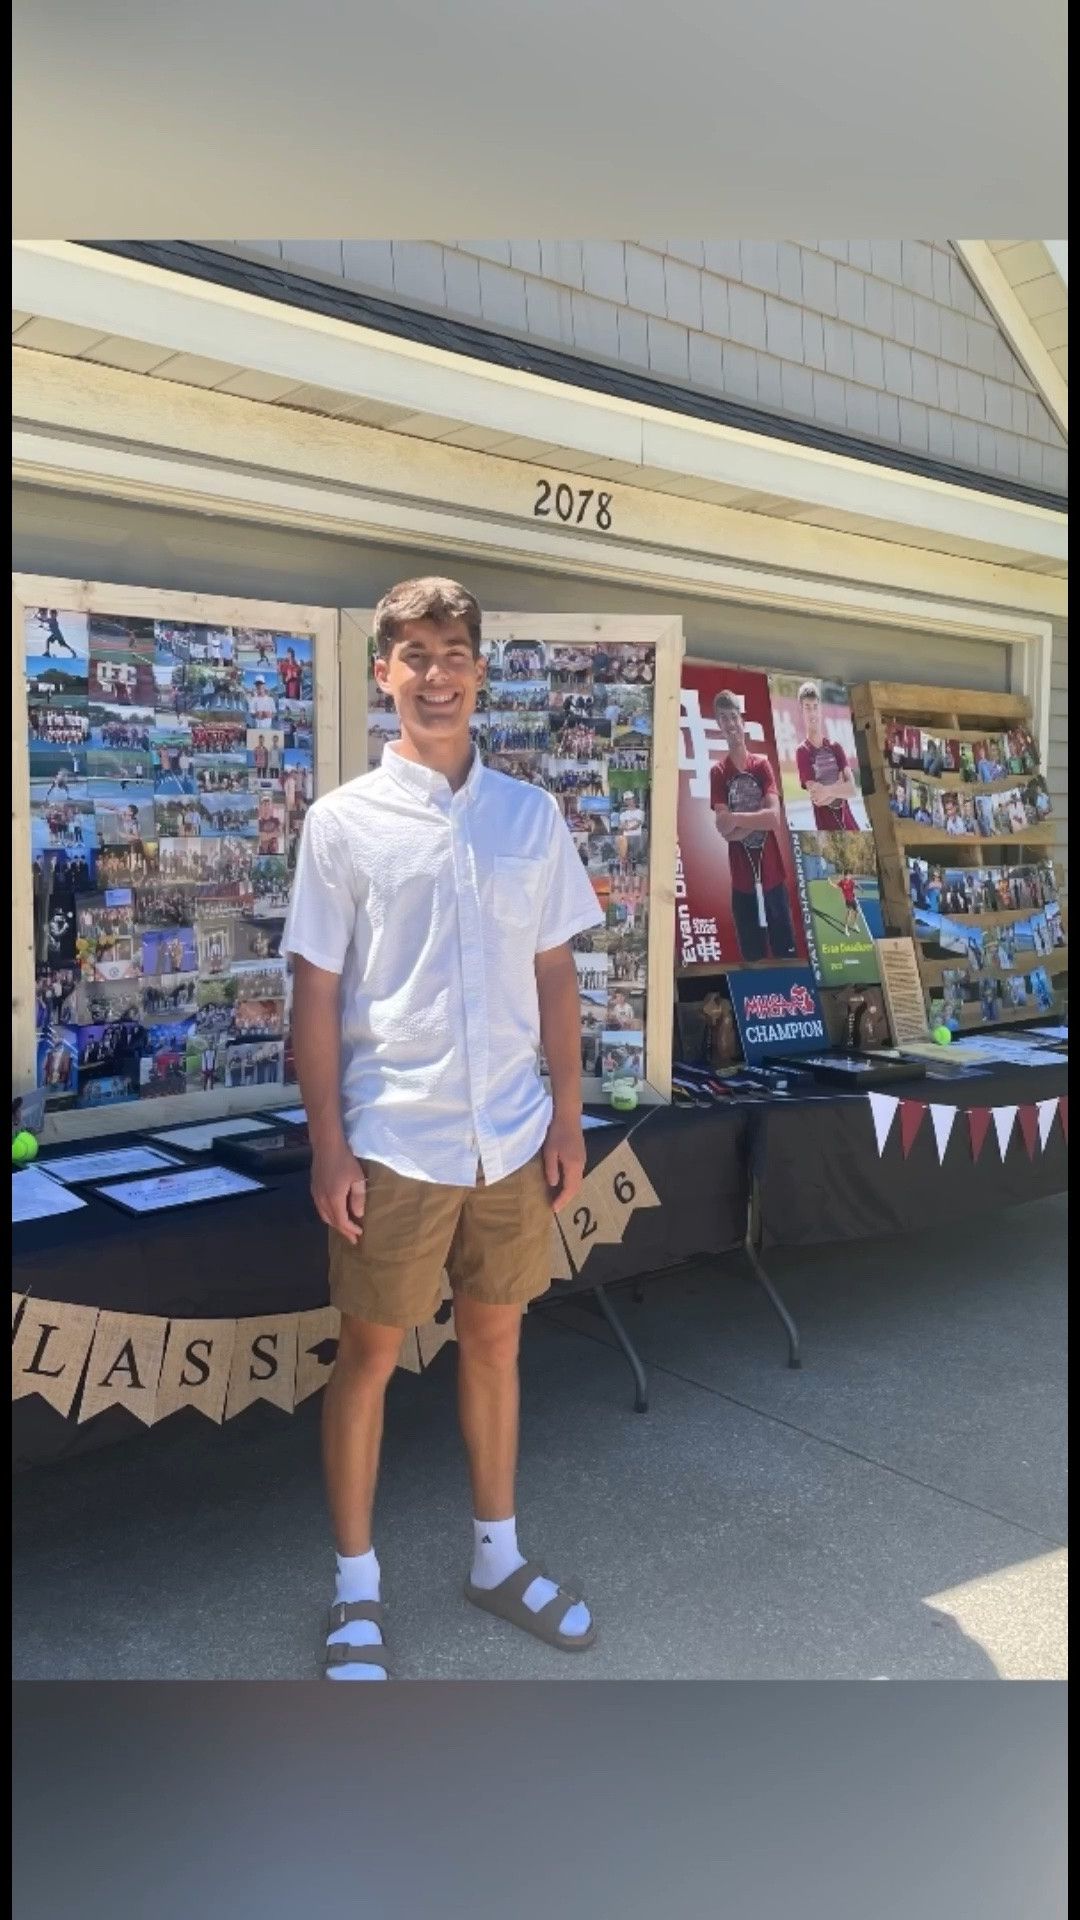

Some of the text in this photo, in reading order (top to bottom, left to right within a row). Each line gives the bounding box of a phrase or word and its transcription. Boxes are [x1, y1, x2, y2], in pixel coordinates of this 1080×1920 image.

[534, 479, 613, 530] 2078
[791, 833, 811, 924] CHAMPION
[678, 904, 697, 962] Evan
[745, 1019, 824, 1044] CHAMPION
